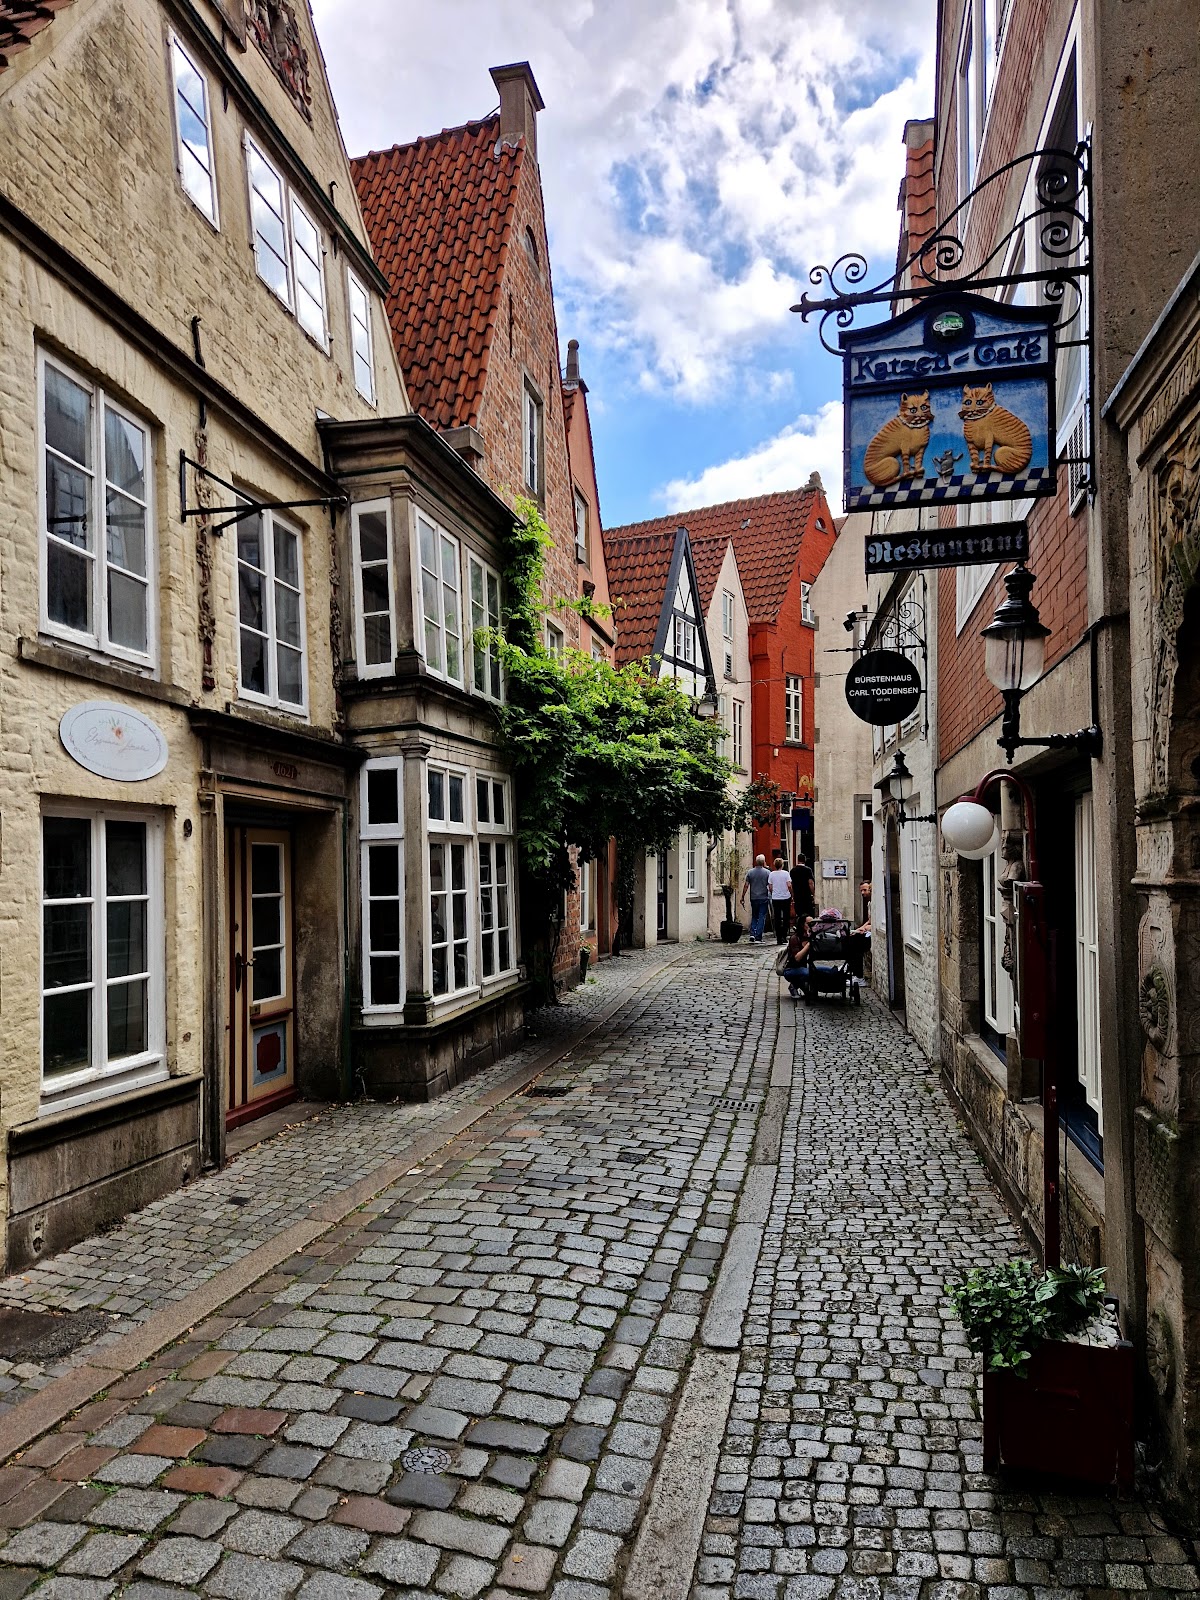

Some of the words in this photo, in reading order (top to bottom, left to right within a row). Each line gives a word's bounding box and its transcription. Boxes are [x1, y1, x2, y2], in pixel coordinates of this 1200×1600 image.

[932, 320, 963, 333] Carlsberg
[868, 529, 1024, 564] Restaurant
[854, 674, 912, 684] BÜRSTENHAUS
[849, 689, 870, 697] CARL
[871, 687, 919, 696] TÖDDENSEN
